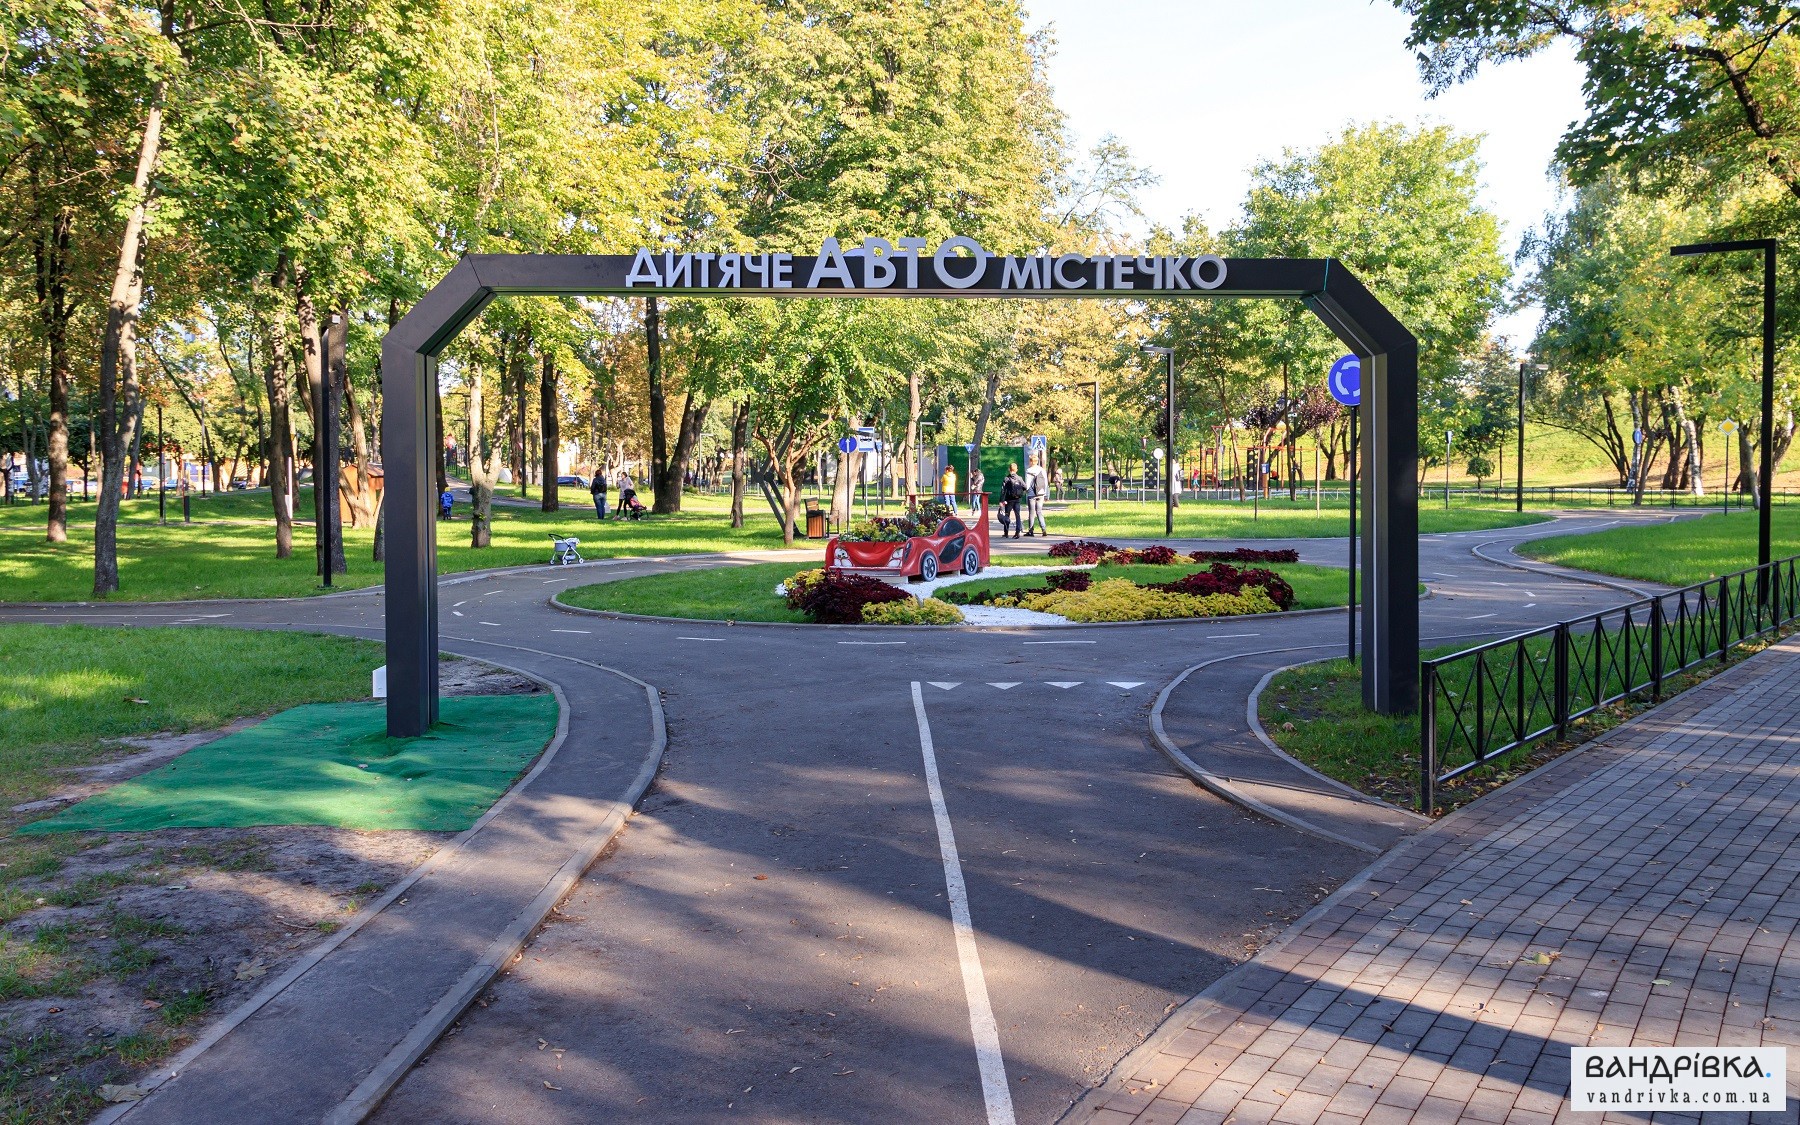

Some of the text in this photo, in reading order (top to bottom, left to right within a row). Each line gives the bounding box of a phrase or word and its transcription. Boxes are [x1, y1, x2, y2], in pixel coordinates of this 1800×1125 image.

[625, 236, 1228, 290] ДИТЯЧЕ АВТО МІСТЕЧКО
